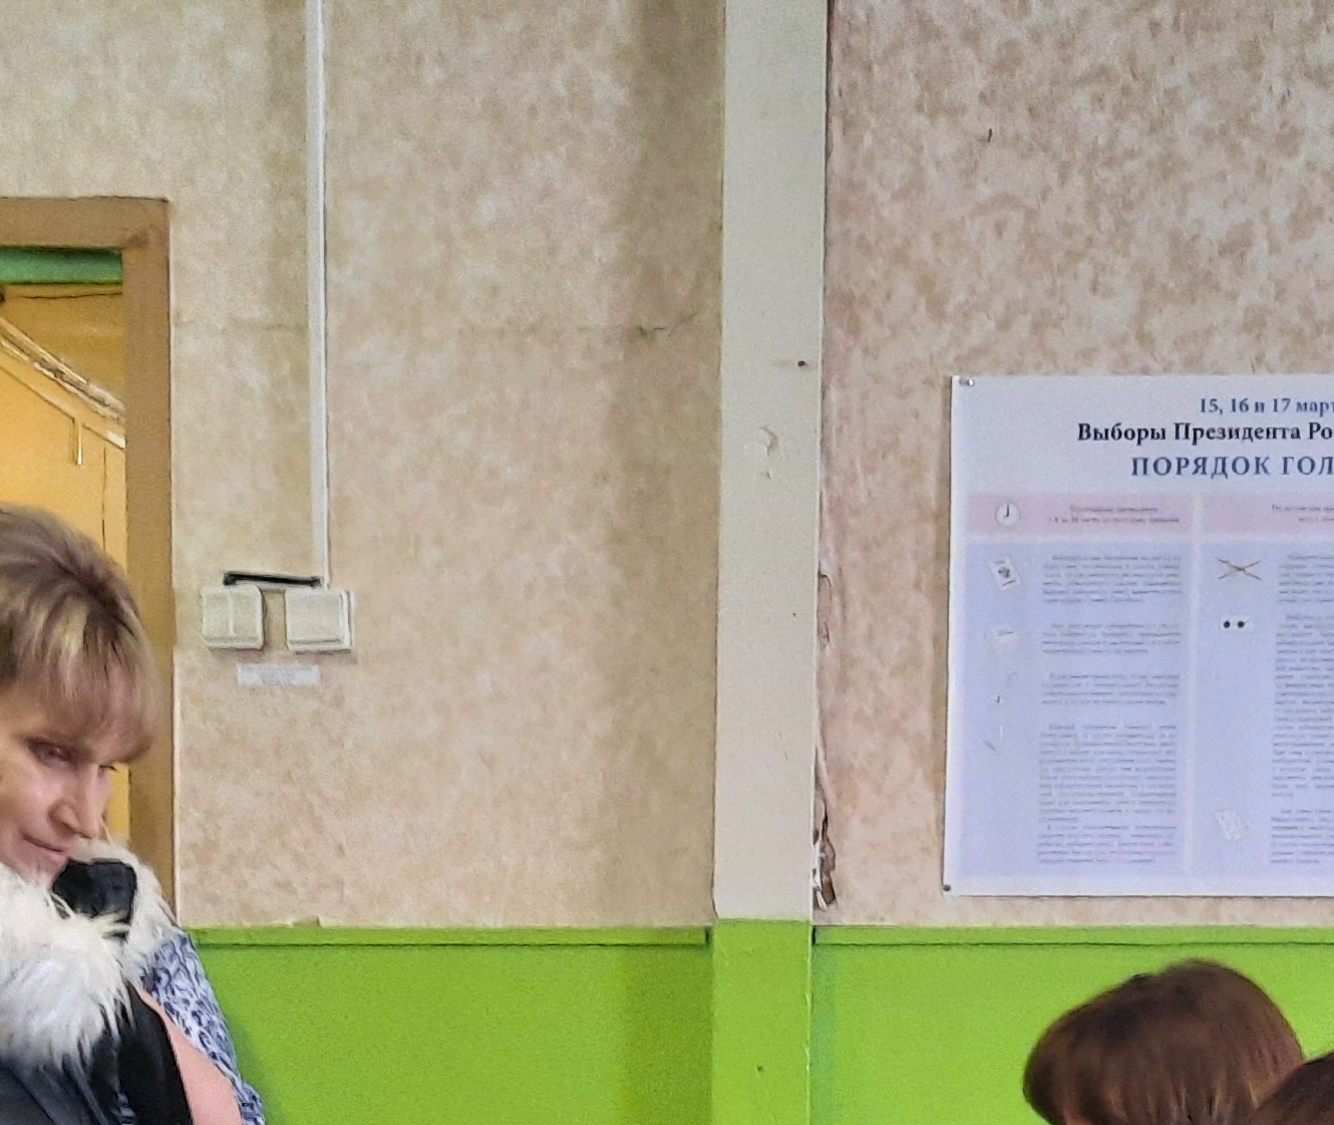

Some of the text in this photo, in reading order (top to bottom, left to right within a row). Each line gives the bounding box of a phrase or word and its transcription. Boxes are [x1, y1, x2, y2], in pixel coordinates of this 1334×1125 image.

[1200, 397, 1224, 416] 15,
[1231, 397, 1250, 413] 16
[1254, 401, 1266, 413] и
[1272, 397, 1292, 413] 17
[1077, 422, 1167, 446] Выборы
[1173, 421, 1302, 447] Президента
[1131, 455, 1270, 480] ПОРЯДОК
